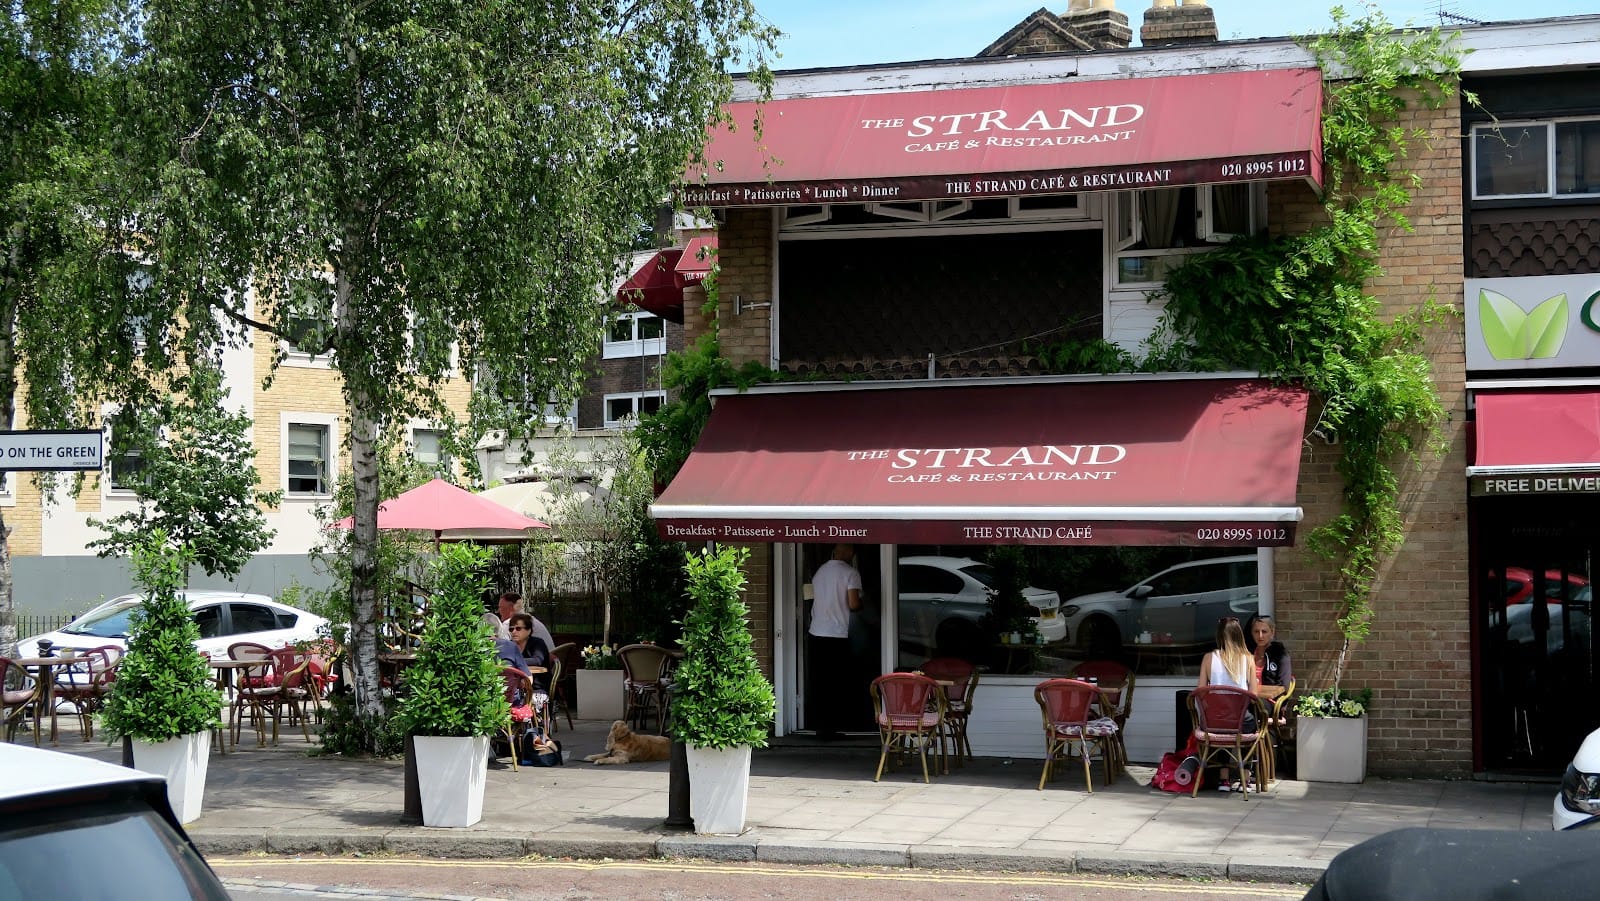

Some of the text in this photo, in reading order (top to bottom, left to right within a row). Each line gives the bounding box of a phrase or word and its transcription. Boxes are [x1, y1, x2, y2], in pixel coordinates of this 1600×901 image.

[861, 104, 1144, 137] THE STRAND
[904, 130, 1136, 153] CAFÉ & RESTAURANT
[1221, 159, 1305, 176] 020 8995 1012
[945, 170, 1172, 194] THE STRAND CAFÉ & RESTAURANT
[744, 187, 801, 200] Patisseries
[814, 186, 848, 198] Lunch
[862, 184, 900, 197] Dinner
[8, 447, 26, 458] ON
[30, 447, 52, 458] THE
[56, 446, 96, 458] GREEN
[847, 444, 1127, 469] THE STRAND
[887, 471, 1117, 483] CAFÉ & RESTAURANT
[1485, 479, 1530, 493] FREE
[666, 525, 868, 537] Breakfast Patisserie Lunch Dinner
[963, 525, 1093, 539] THE STRAND CAFÉ
[1197, 528, 1286, 541] 020 8995 1012
